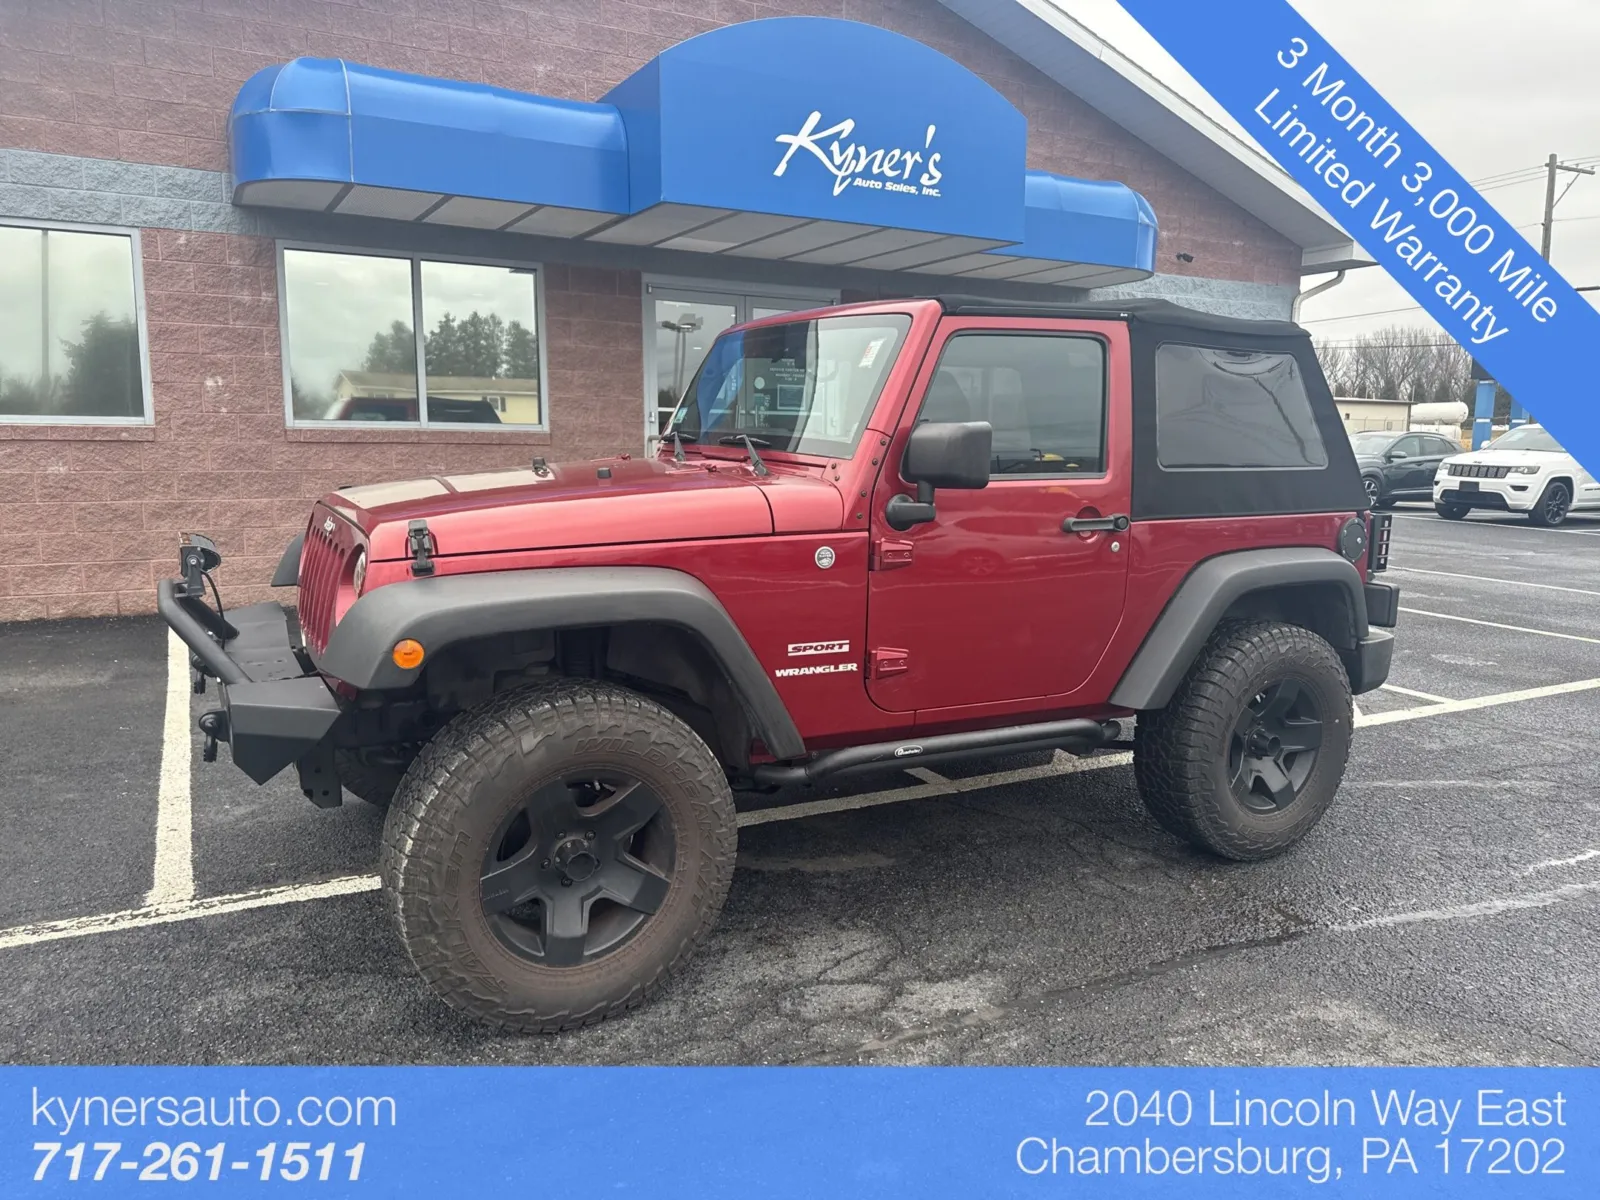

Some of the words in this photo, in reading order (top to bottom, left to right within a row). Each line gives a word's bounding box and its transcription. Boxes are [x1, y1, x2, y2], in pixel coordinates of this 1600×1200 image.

[773, 110, 943, 197] Kyner's
[853, 177, 883, 190] Auto
[884, 181, 919, 195] Sales,
[921, 186, 942, 197] Inc.
[790, 642, 847, 653] SPORT
[775, 662, 859, 678] WRANGLER
